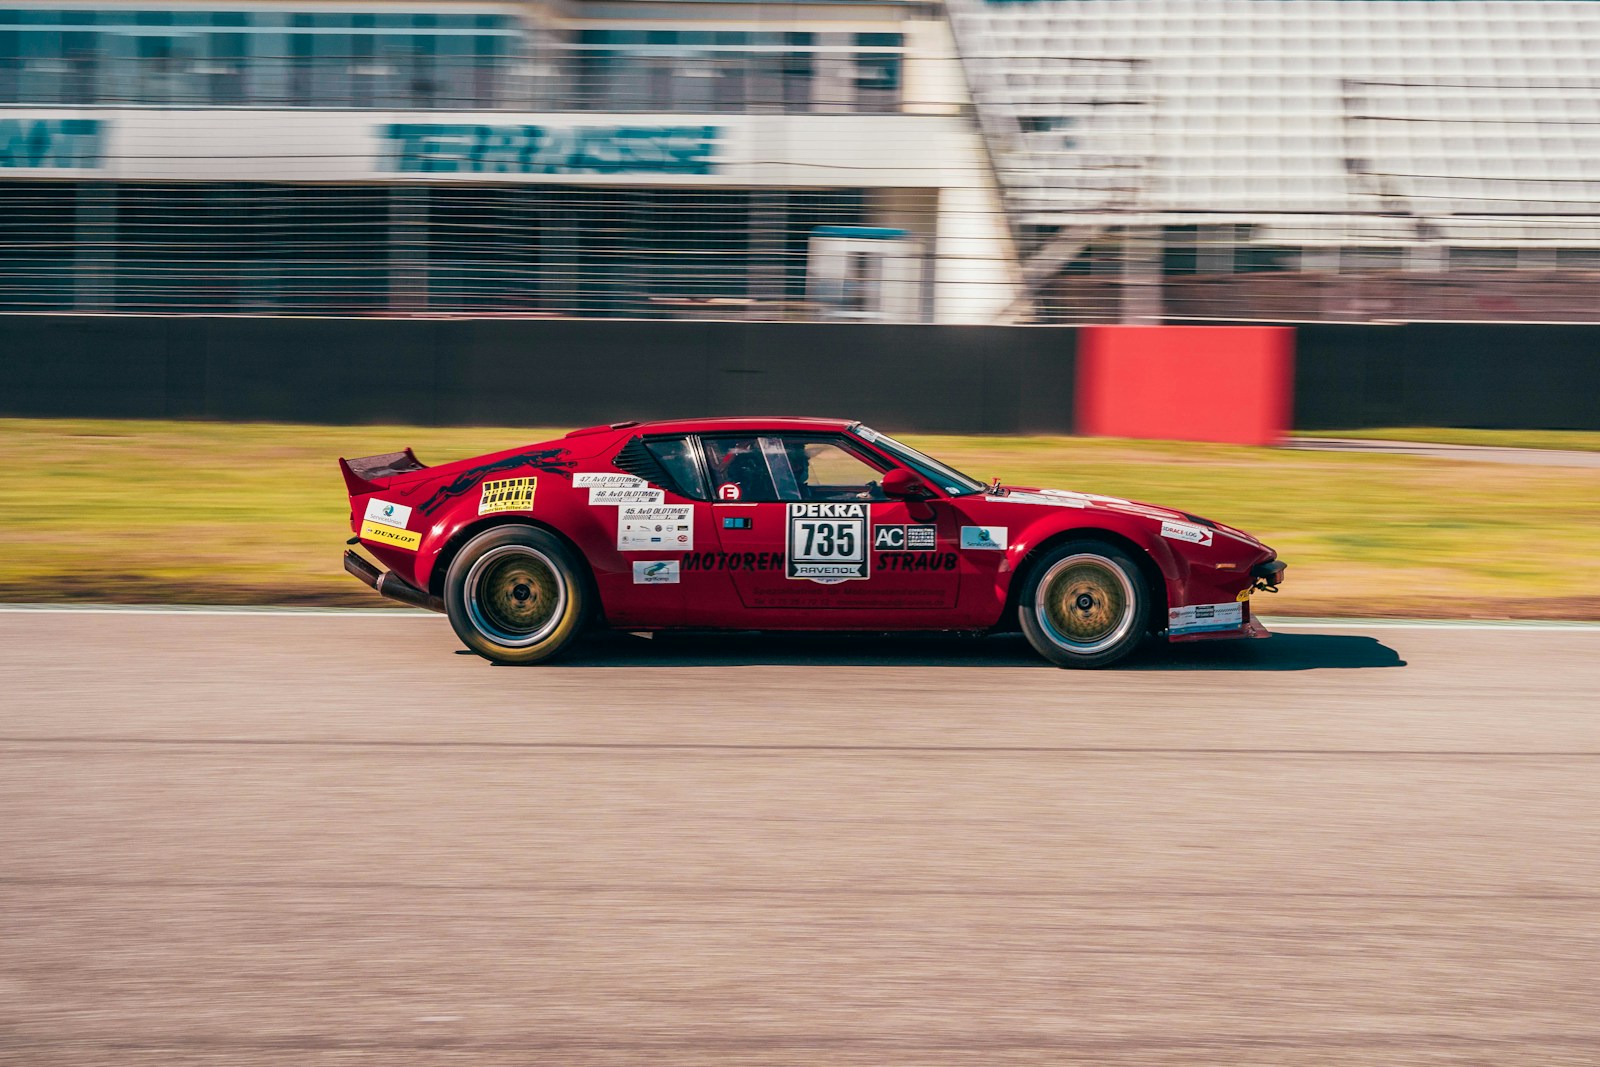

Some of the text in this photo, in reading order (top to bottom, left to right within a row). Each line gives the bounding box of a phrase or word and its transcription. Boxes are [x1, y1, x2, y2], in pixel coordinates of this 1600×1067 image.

[723, 486, 735, 500] E
[791, 504, 865, 517] DEKRA
[373, 529, 416, 543] DUNLOP
[801, 523, 855, 557] 735
[875, 528, 904, 547] AC
[681, 551, 958, 572] MOTOREN STRAUB
